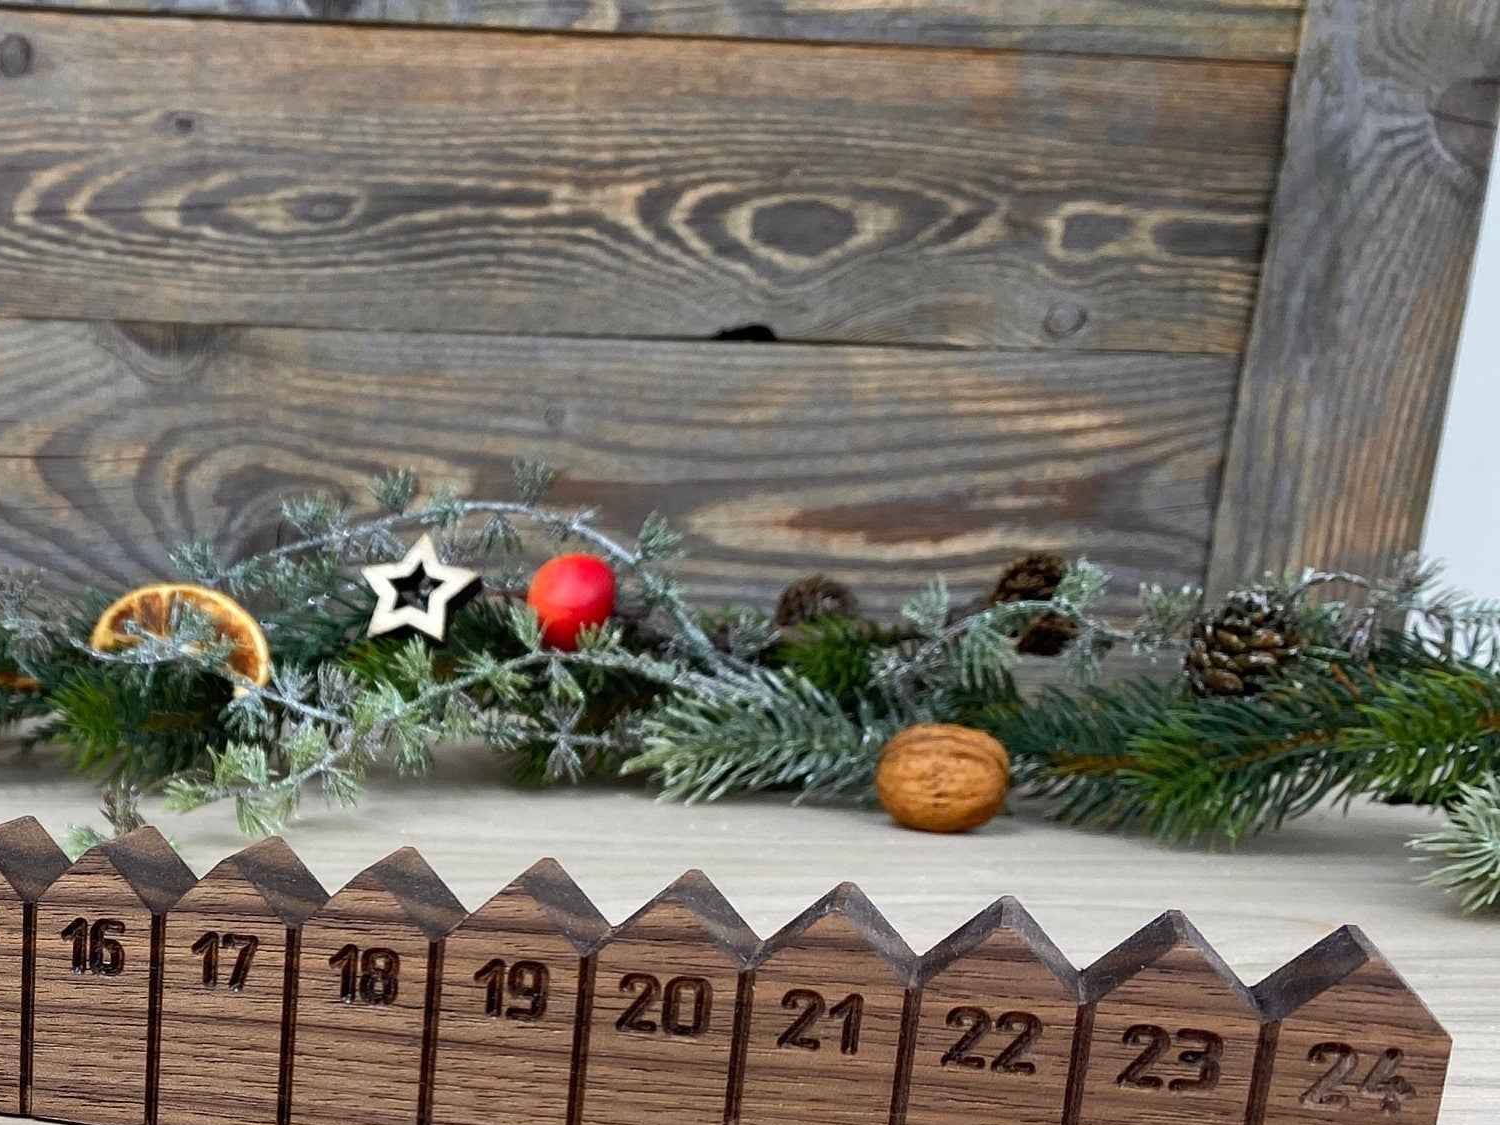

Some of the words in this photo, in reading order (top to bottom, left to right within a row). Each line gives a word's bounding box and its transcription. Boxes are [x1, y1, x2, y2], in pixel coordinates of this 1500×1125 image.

[60, 916, 126, 977] 16
[190, 930, 260, 993] 17
[327, 943, 400, 1006] 18
[473, 958, 551, 1021] 19
[613, 972, 714, 1037] 20
[775, 987, 865, 1056] 21
[940, 1005, 1045, 1076] 22
[1115, 1023, 1225, 1093] 23
[1299, 1041, 1417, 1114] 24
